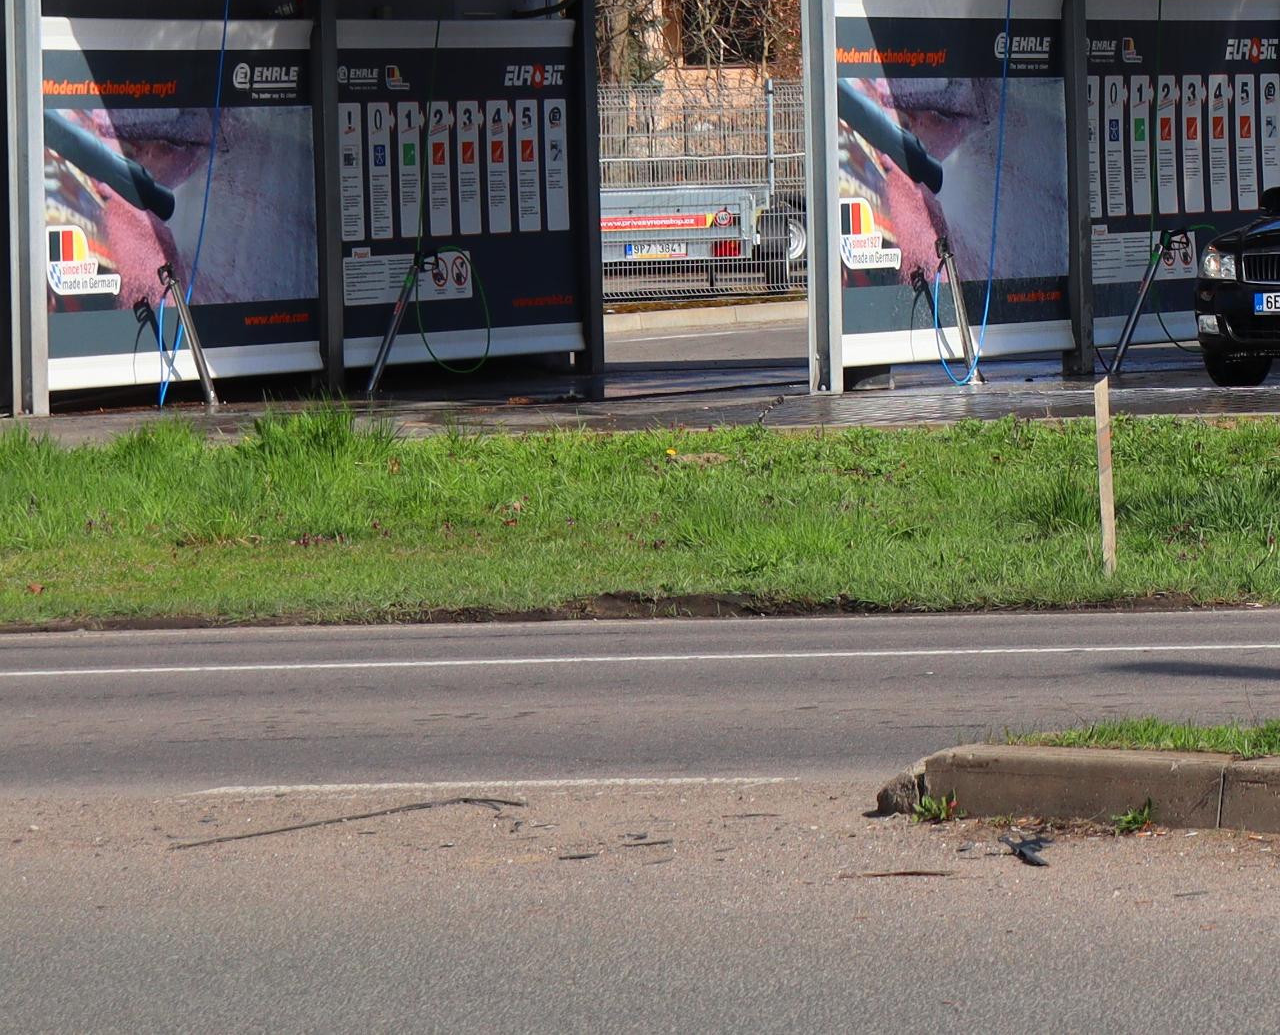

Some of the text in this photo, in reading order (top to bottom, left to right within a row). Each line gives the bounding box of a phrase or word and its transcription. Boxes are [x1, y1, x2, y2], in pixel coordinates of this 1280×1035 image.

[1012, 36, 1050, 52] EHRLE
[836, 47, 872, 63] Moderní
[873, 49, 925, 66] technologie
[253, 66, 298, 82] EHRLE
[42, 79, 177, 98] Moderní technologie mytí
[1110, 82, 1117, 104] 0
[1137, 83, 1143, 102] 1
[1162, 83, 1171, 100] 2
[1188, 82, 1196, 102] 3
[1214, 82, 1223, 99] 4
[1241, 82, 1249, 101] 5
[374, 109, 382, 129] 0
[404, 109, 412, 127] 1
[433, 109, 443, 125] 2
[463, 108, 472, 127] 3
[492, 107, 502, 125] 4
[522, 107, 531, 126] 5
[853, 252, 867, 264] made
[874, 251, 900, 265] Germany
[62, 276, 118, 290] made in Germany
